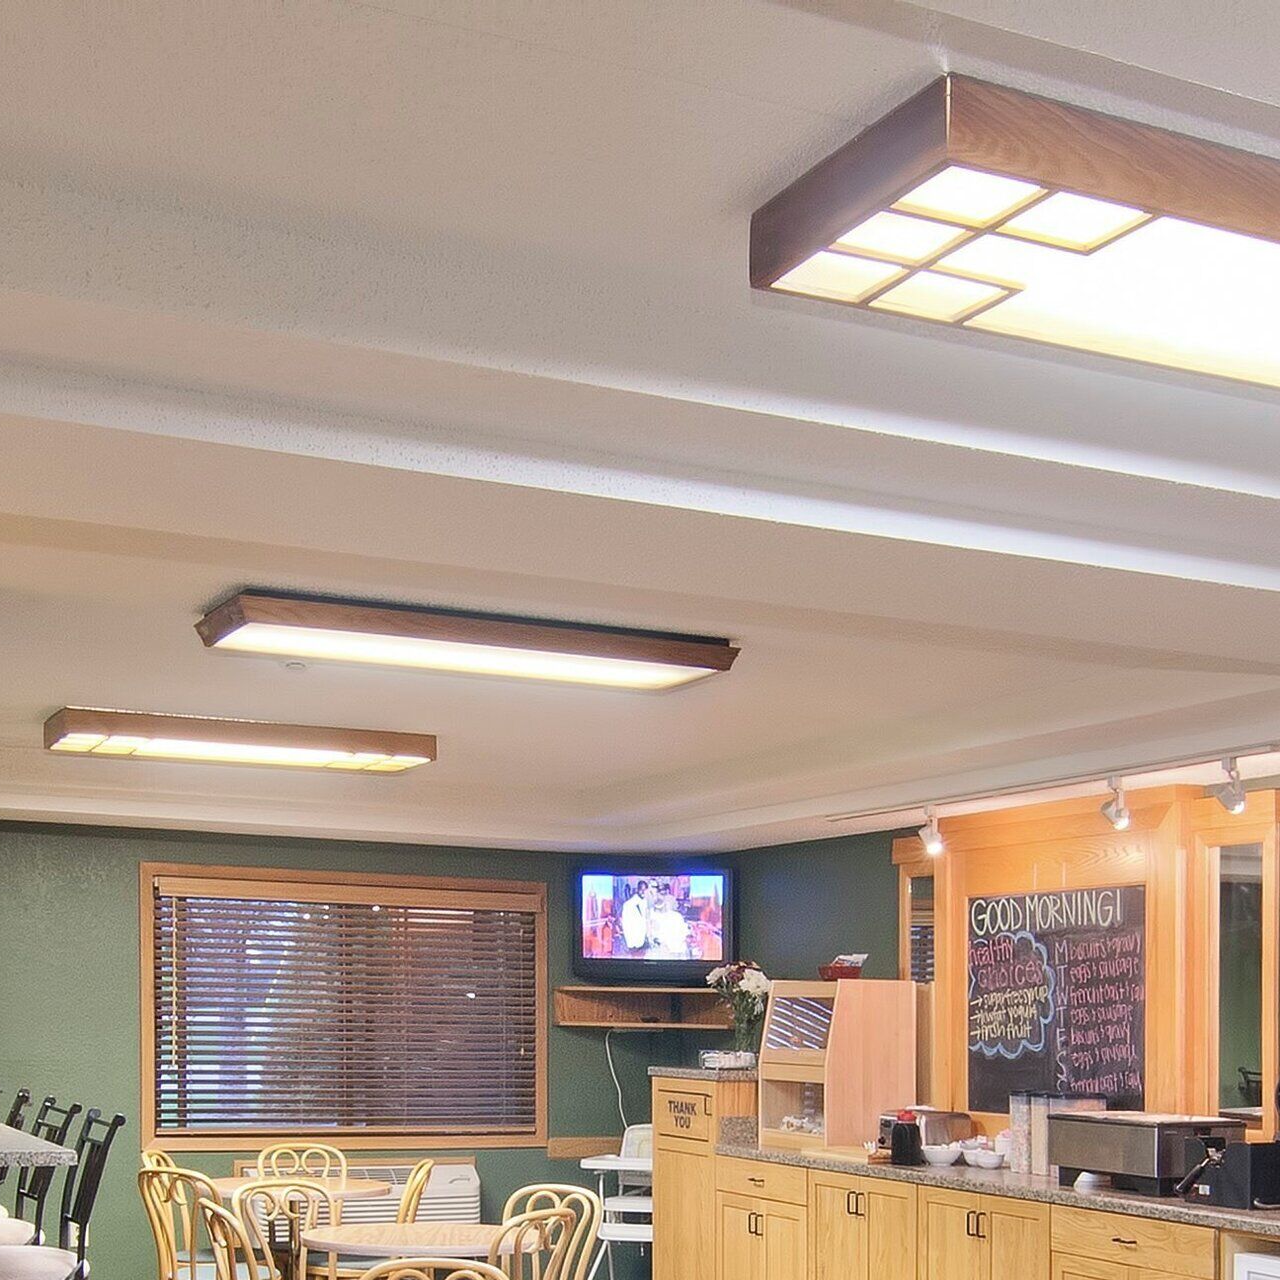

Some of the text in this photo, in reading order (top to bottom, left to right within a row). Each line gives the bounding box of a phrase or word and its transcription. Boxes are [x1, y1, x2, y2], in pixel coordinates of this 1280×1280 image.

[971, 888, 1122, 936] GOOD MORNING!
[1054, 939, 1068, 965] M
[977, 961, 1044, 990] choices
[1056, 964, 1069, 988] T
[1056, 1006, 1068, 1028] T
[1056, 1027, 1066, 1051] F
[668, 1100, 697, 1116] THANK
[674, 1115, 691, 1128] YOU
